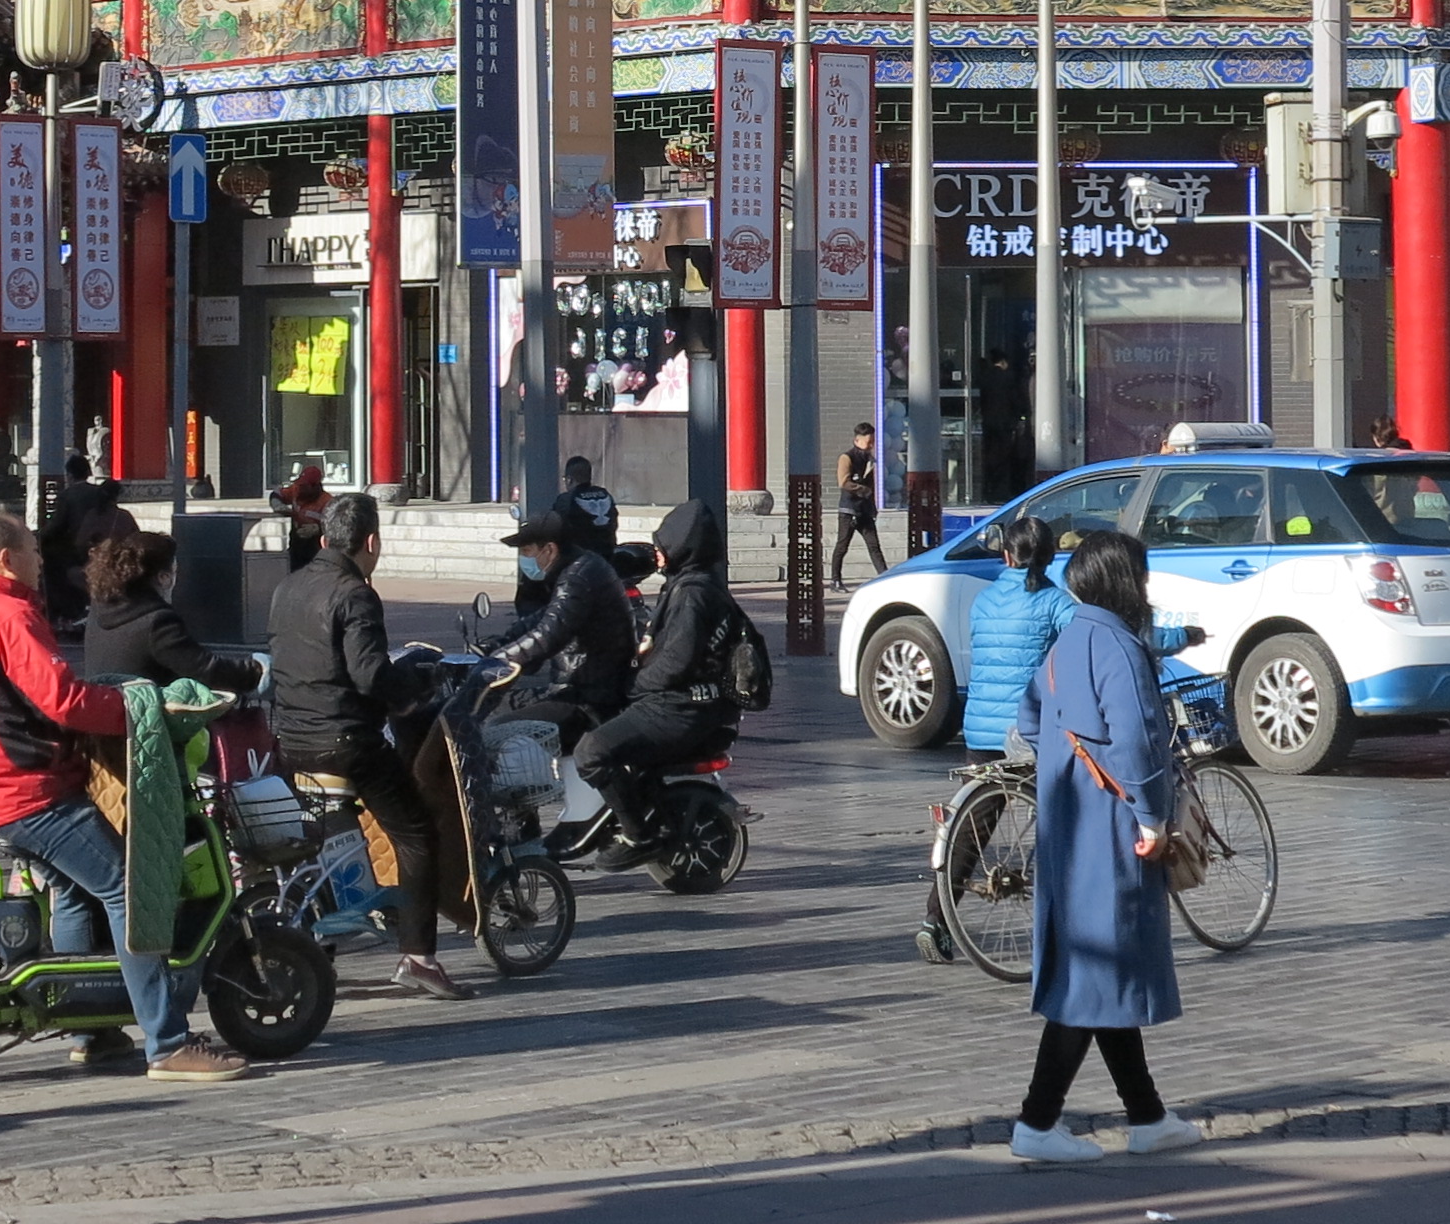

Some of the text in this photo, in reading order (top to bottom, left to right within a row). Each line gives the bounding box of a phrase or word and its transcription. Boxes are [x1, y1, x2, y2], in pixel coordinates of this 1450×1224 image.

[23, 195, 35, 262] 修身律己
[99, 197, 109, 263] 修身律己
